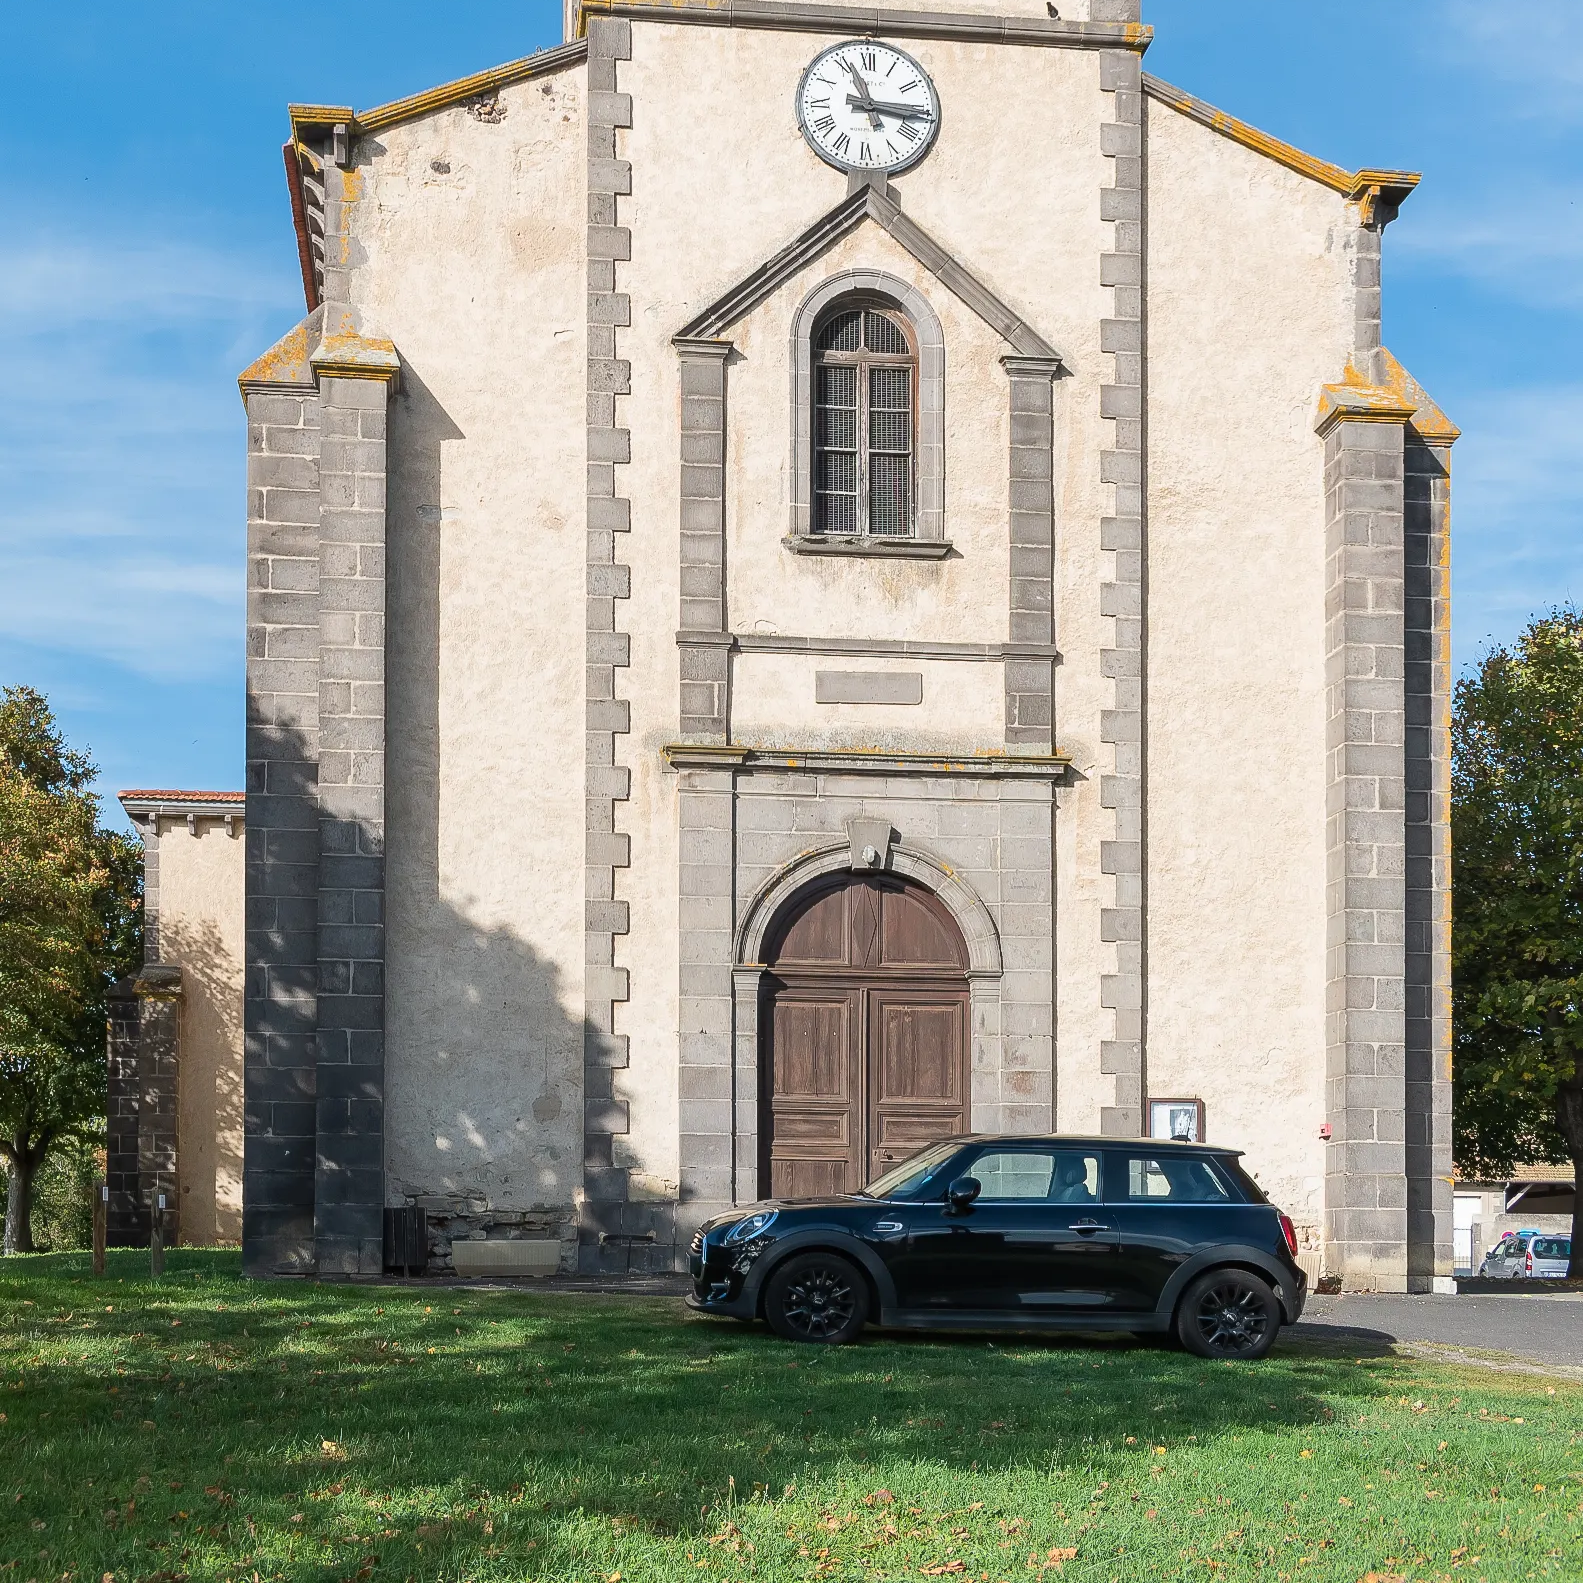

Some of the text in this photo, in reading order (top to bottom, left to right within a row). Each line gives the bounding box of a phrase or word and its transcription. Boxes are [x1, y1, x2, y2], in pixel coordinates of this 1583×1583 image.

[860, 52, 876, 72] XII
[886, 61, 897, 77] I
[816, 73, 837, 90] X
[899, 80, 918, 94] II
[810, 95, 830, 109] IX
[814, 113, 836, 139] VIII
[833, 132, 851, 155] VII
[860, 142, 873, 161] VI
[886, 139, 900, 157] V
